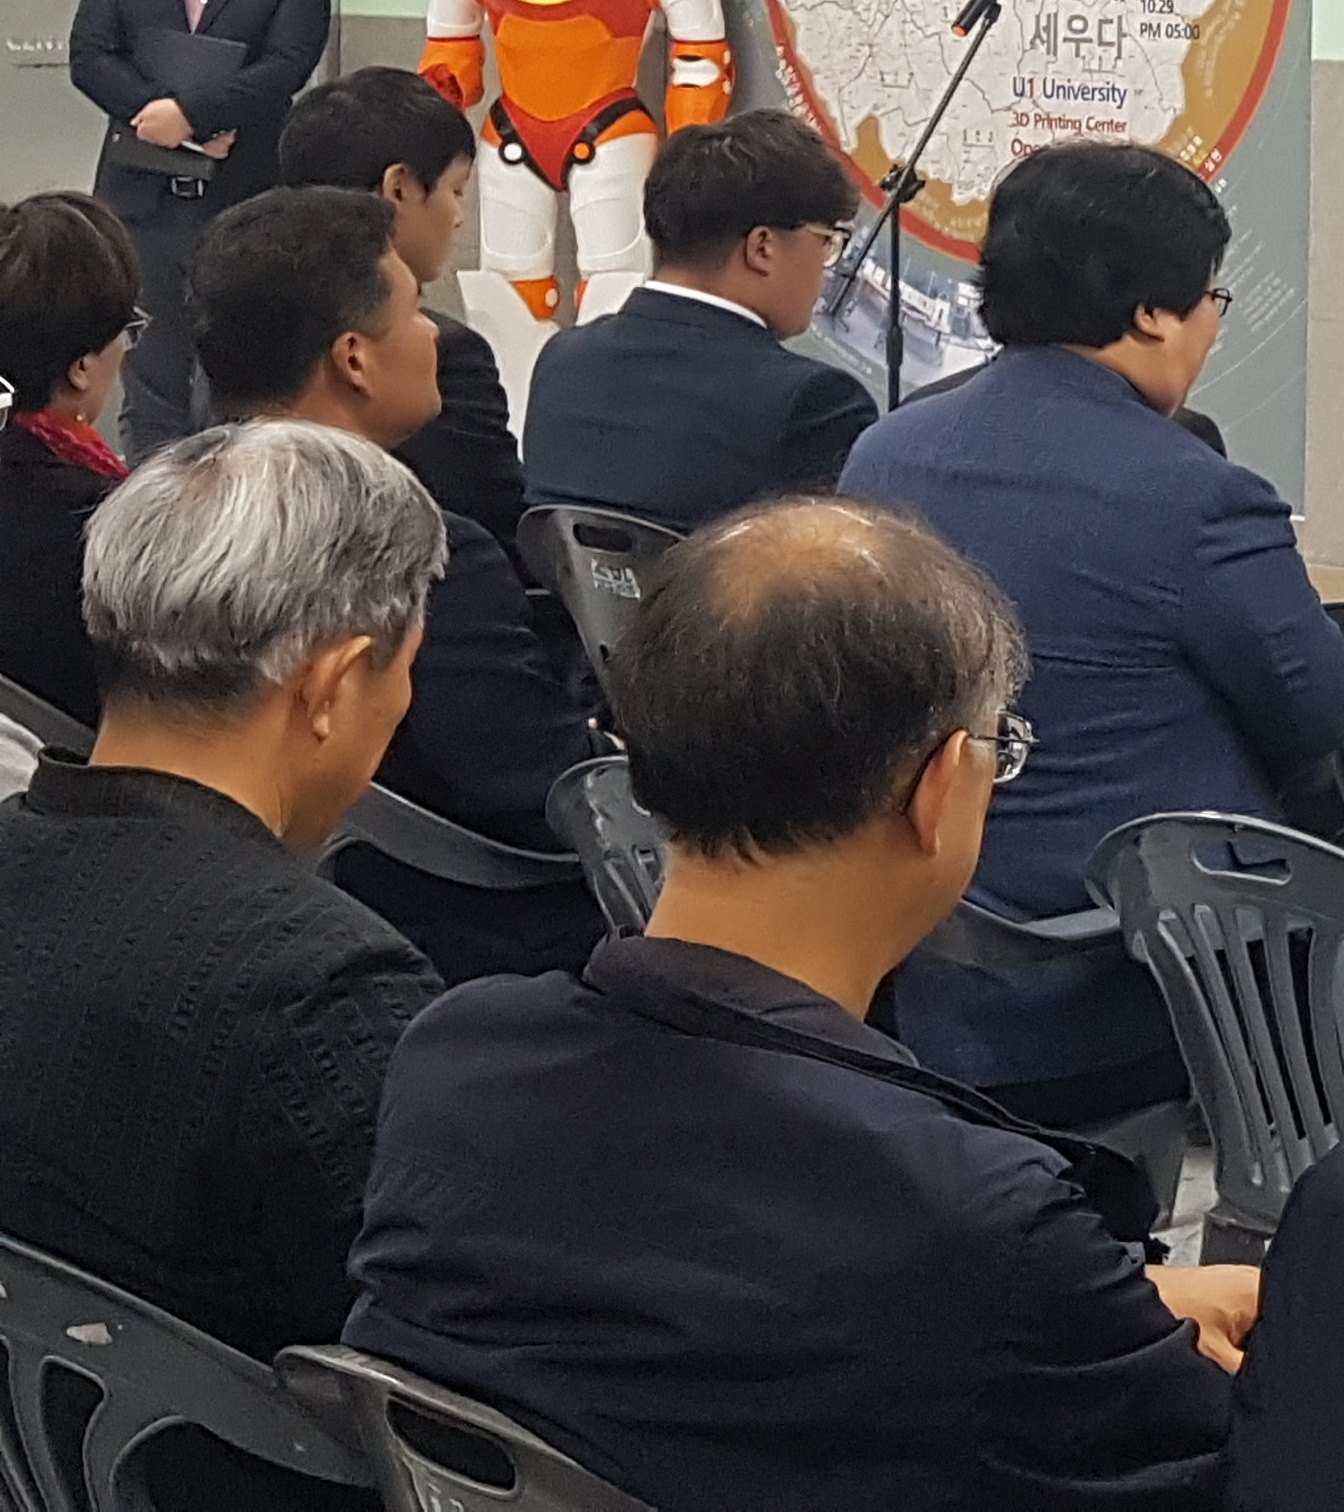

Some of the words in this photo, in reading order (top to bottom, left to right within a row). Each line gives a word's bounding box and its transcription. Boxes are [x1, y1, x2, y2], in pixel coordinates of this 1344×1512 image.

[1030, 13, 1128, 59] 세우다
[1140, 22, 1161, 39] PM
[1165, 23, 1200, 40] 05:00
[1012, 76, 1036, 98] U1
[1043, 76, 1128, 109] University
[1012, 111, 1030, 127] 3D
[1034, 113, 1082, 134] Printing
[1086, 116, 1127, 133] Center
